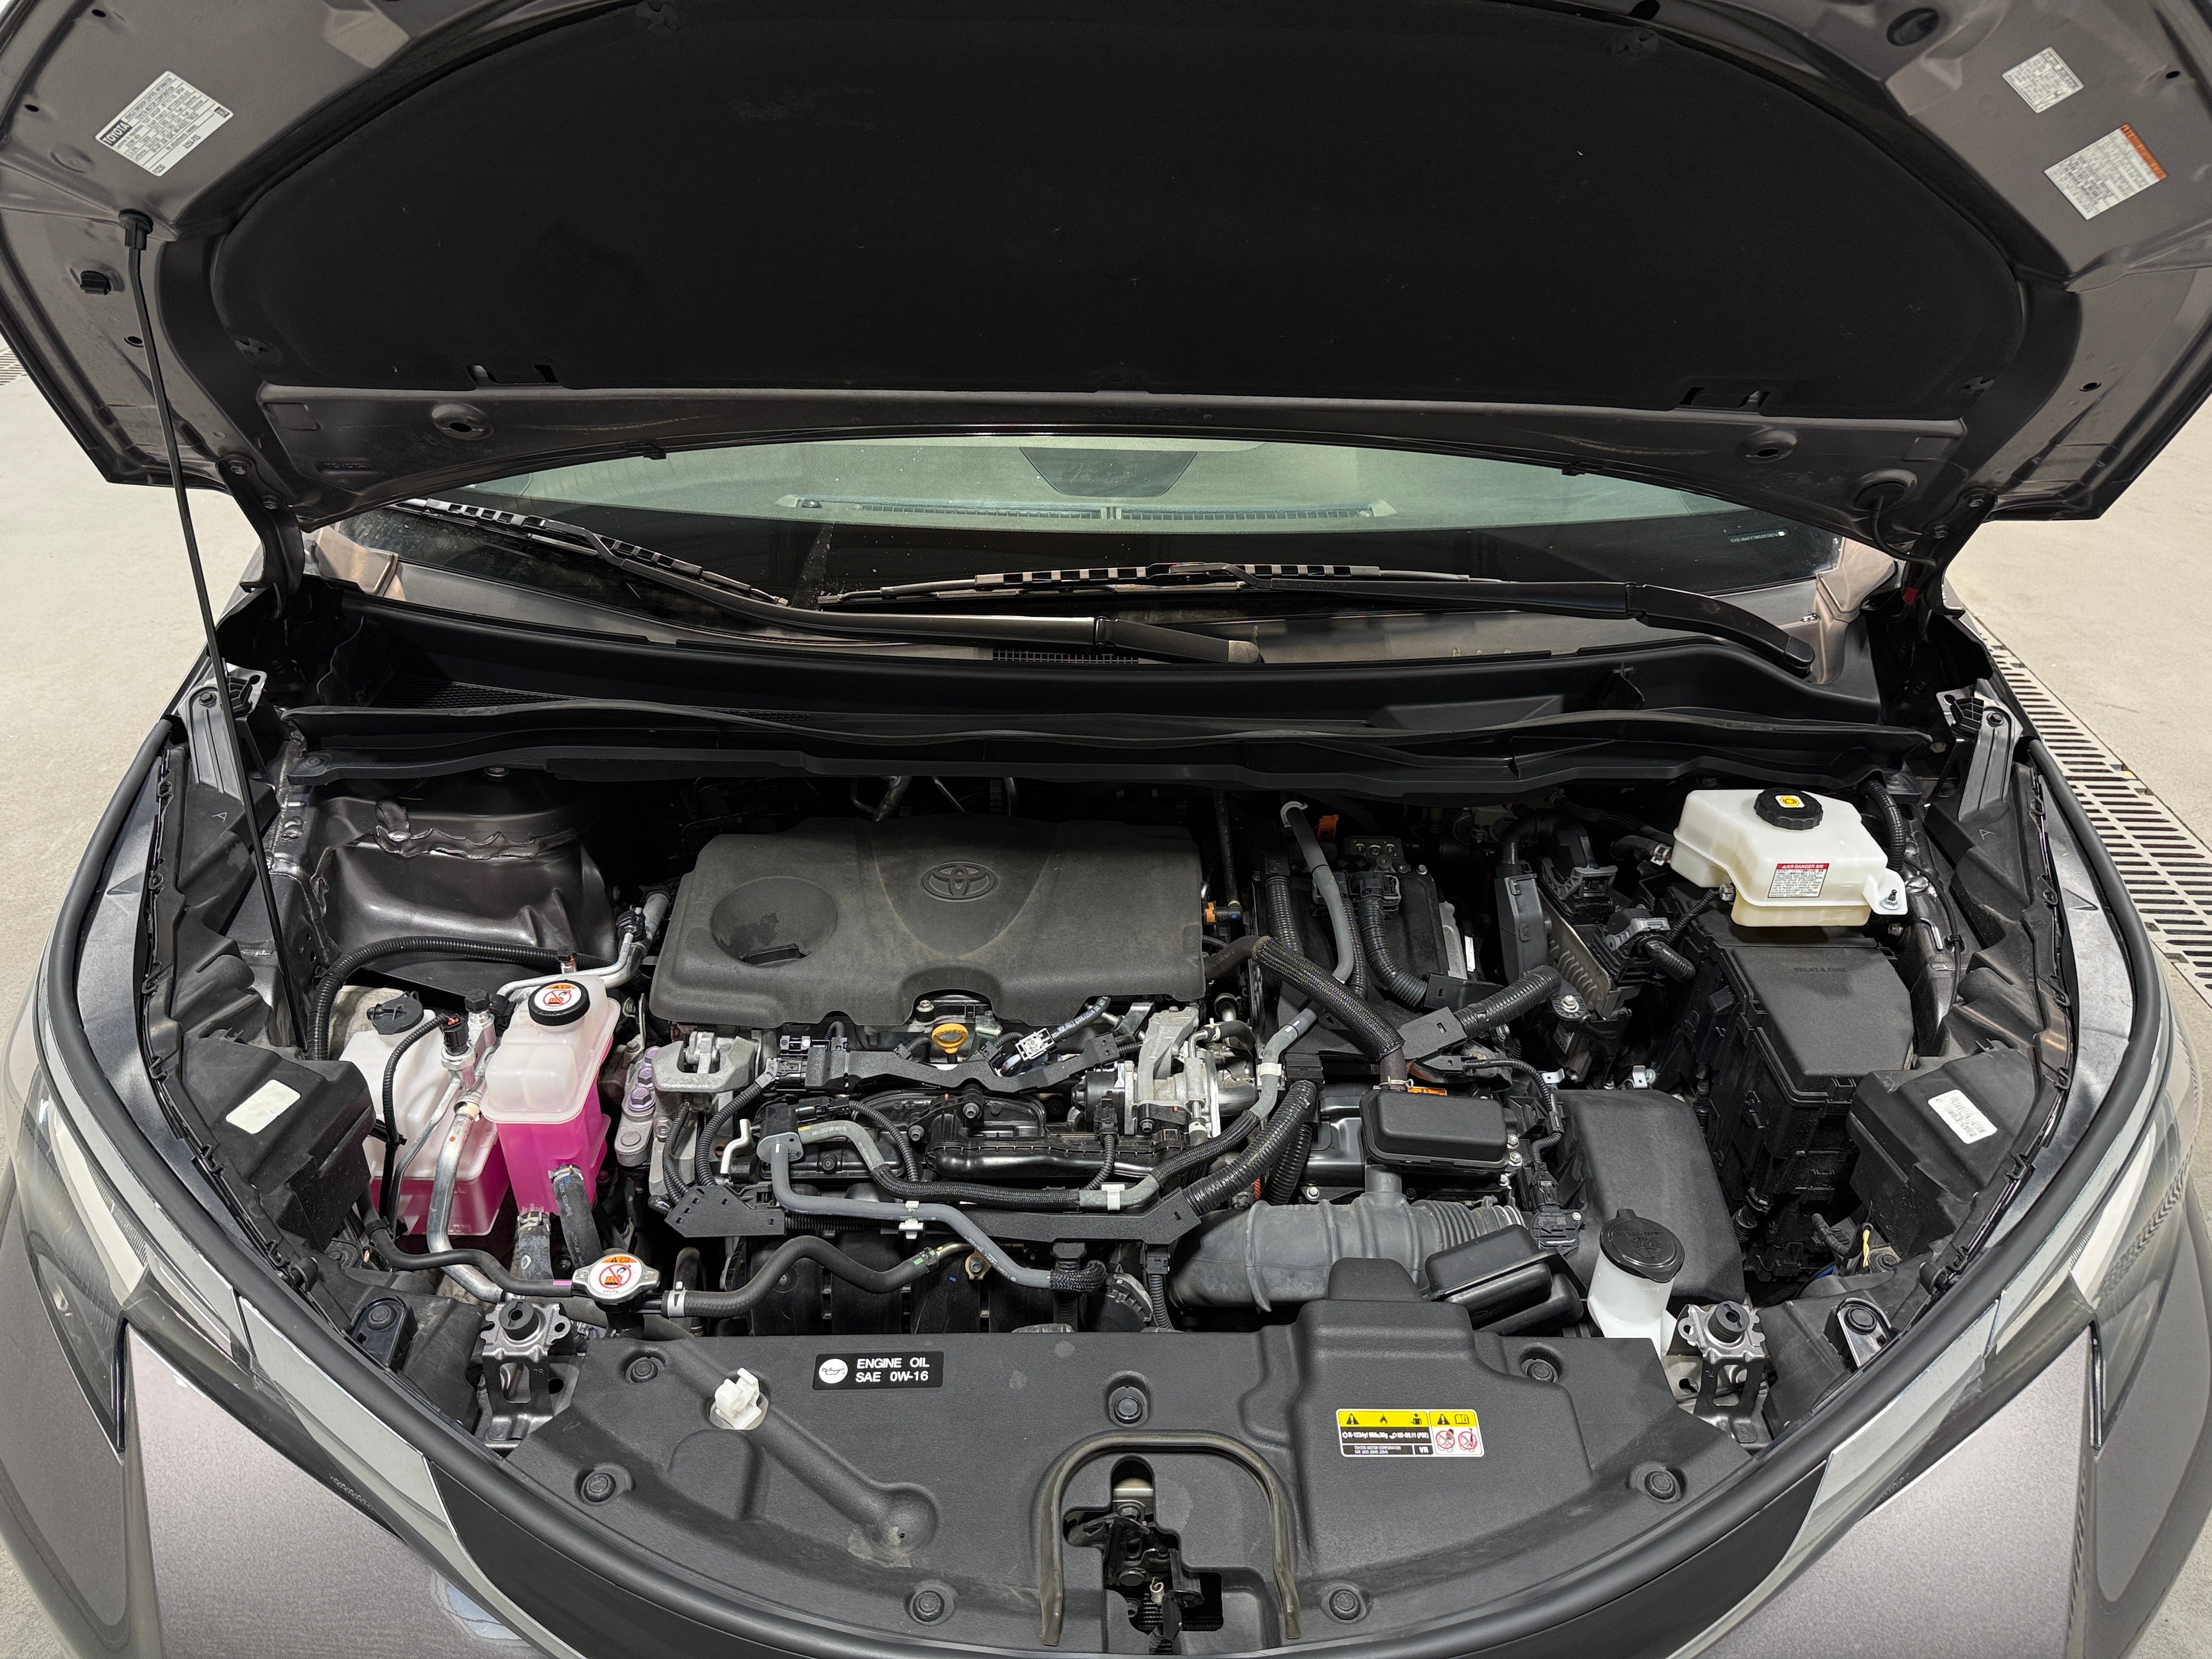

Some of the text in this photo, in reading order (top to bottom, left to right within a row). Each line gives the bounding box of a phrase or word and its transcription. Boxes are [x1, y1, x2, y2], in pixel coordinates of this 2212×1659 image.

[103, 123, 131, 145] TOYOTA
[857, 1357, 930, 1369] ENGINE OIL
[855, 1370, 929, 1383] SAE 0W-16
